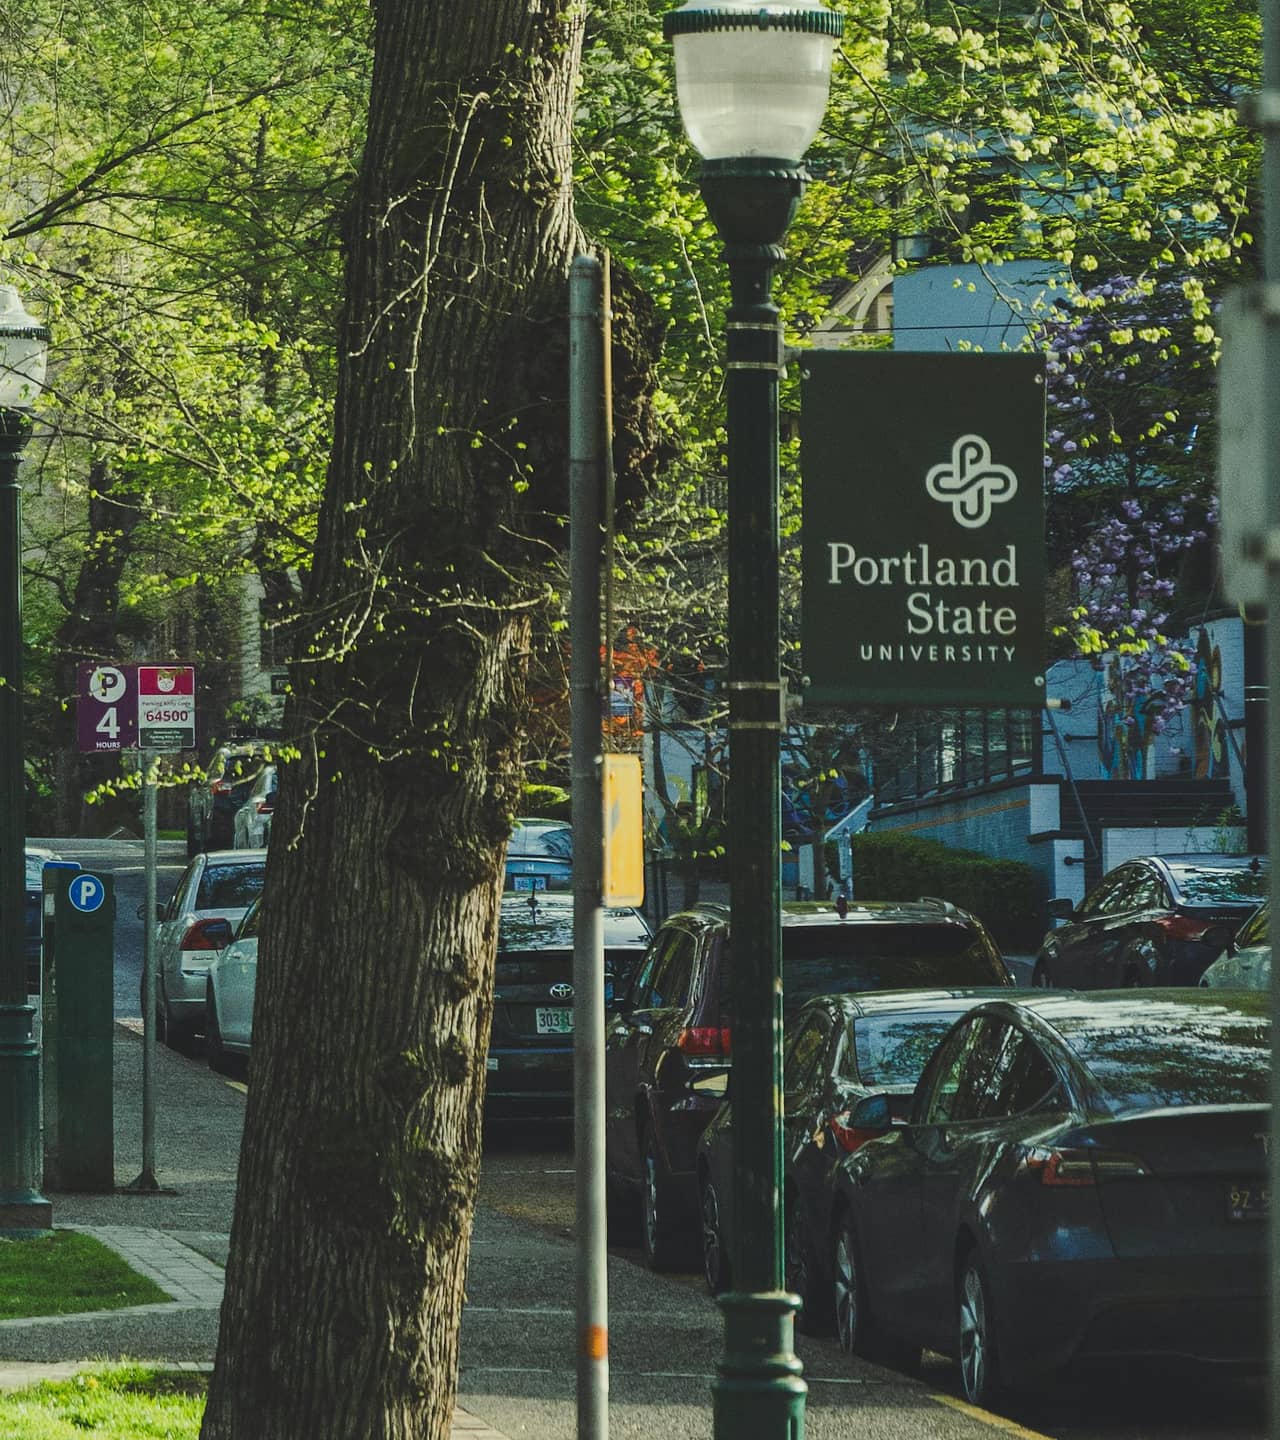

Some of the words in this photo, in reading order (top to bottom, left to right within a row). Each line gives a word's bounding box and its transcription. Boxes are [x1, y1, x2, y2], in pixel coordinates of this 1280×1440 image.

[827, 542, 1019, 587] Portland
[907, 592, 1017, 635] State
[860, 644, 1016, 662] UNIVERSITY
[96, 707, 120, 738] 4
[146, 710, 189, 722] 64500
[80, 881, 96, 906] P
